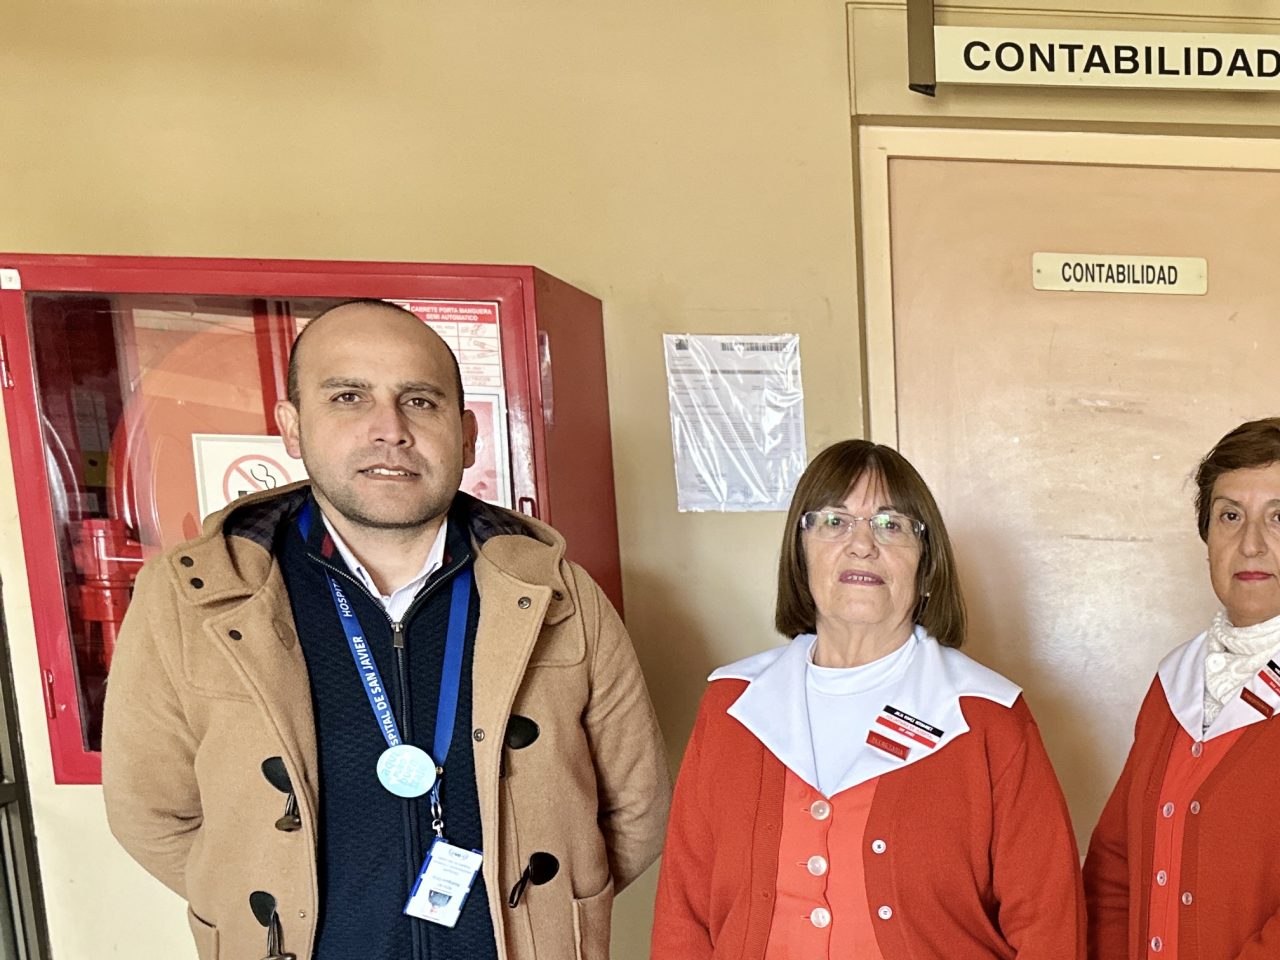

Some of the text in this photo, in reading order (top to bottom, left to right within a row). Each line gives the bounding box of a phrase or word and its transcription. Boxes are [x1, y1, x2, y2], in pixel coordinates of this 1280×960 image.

[1061, 262, 1178, 285] CONTABILIDAD
[352, 636, 374, 670] JAVIER
[365, 672, 383, 694] SAN
[374, 694, 388, 711] DE
[381, 710, 400, 748] SPITAL
